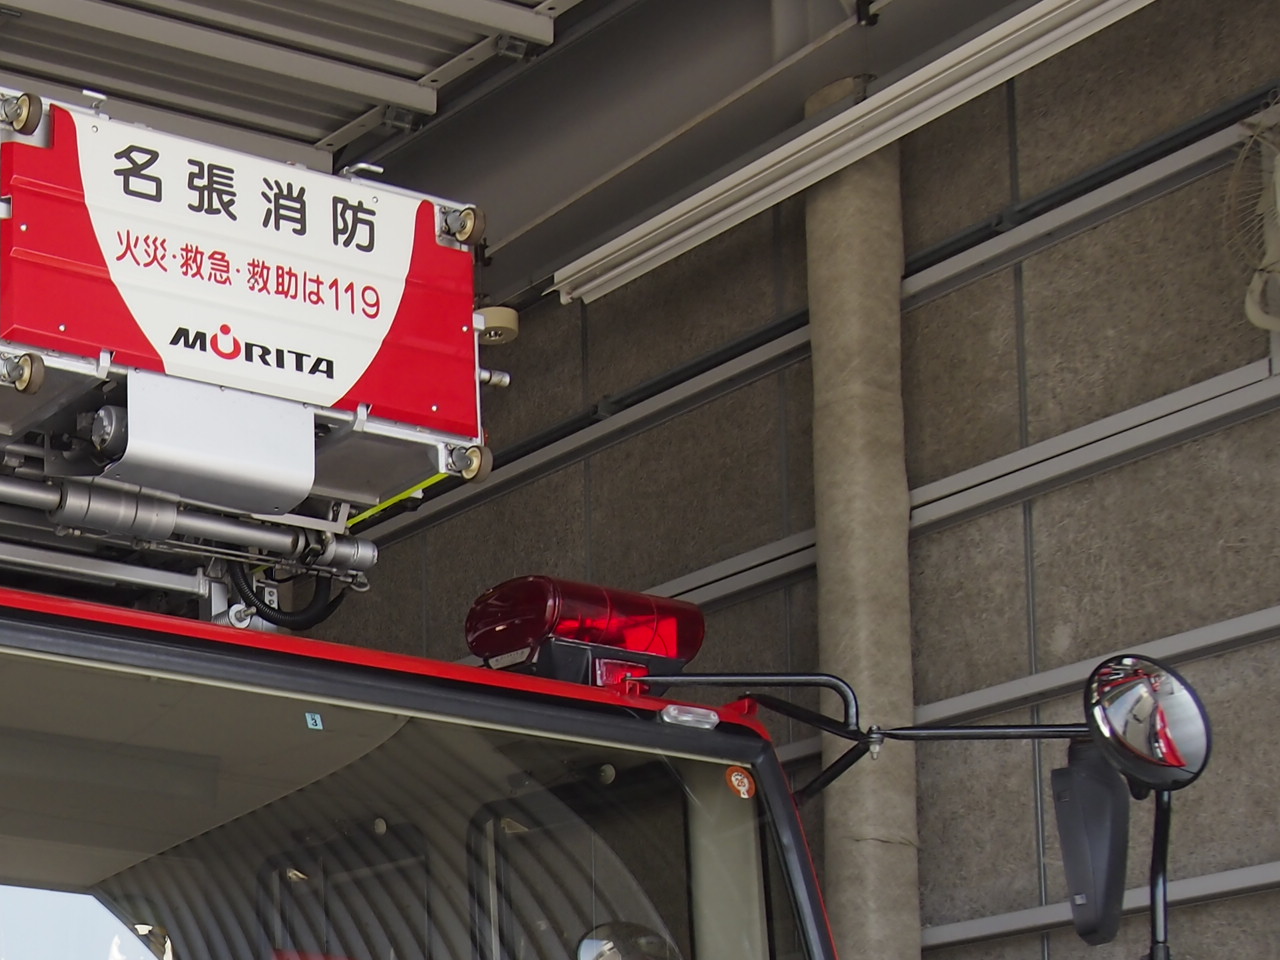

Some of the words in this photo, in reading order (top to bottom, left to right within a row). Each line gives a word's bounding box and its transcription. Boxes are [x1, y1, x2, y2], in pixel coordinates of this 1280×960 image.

[113, 144, 377, 253] 名張消防
[169, 323, 335, 380] MORITA
